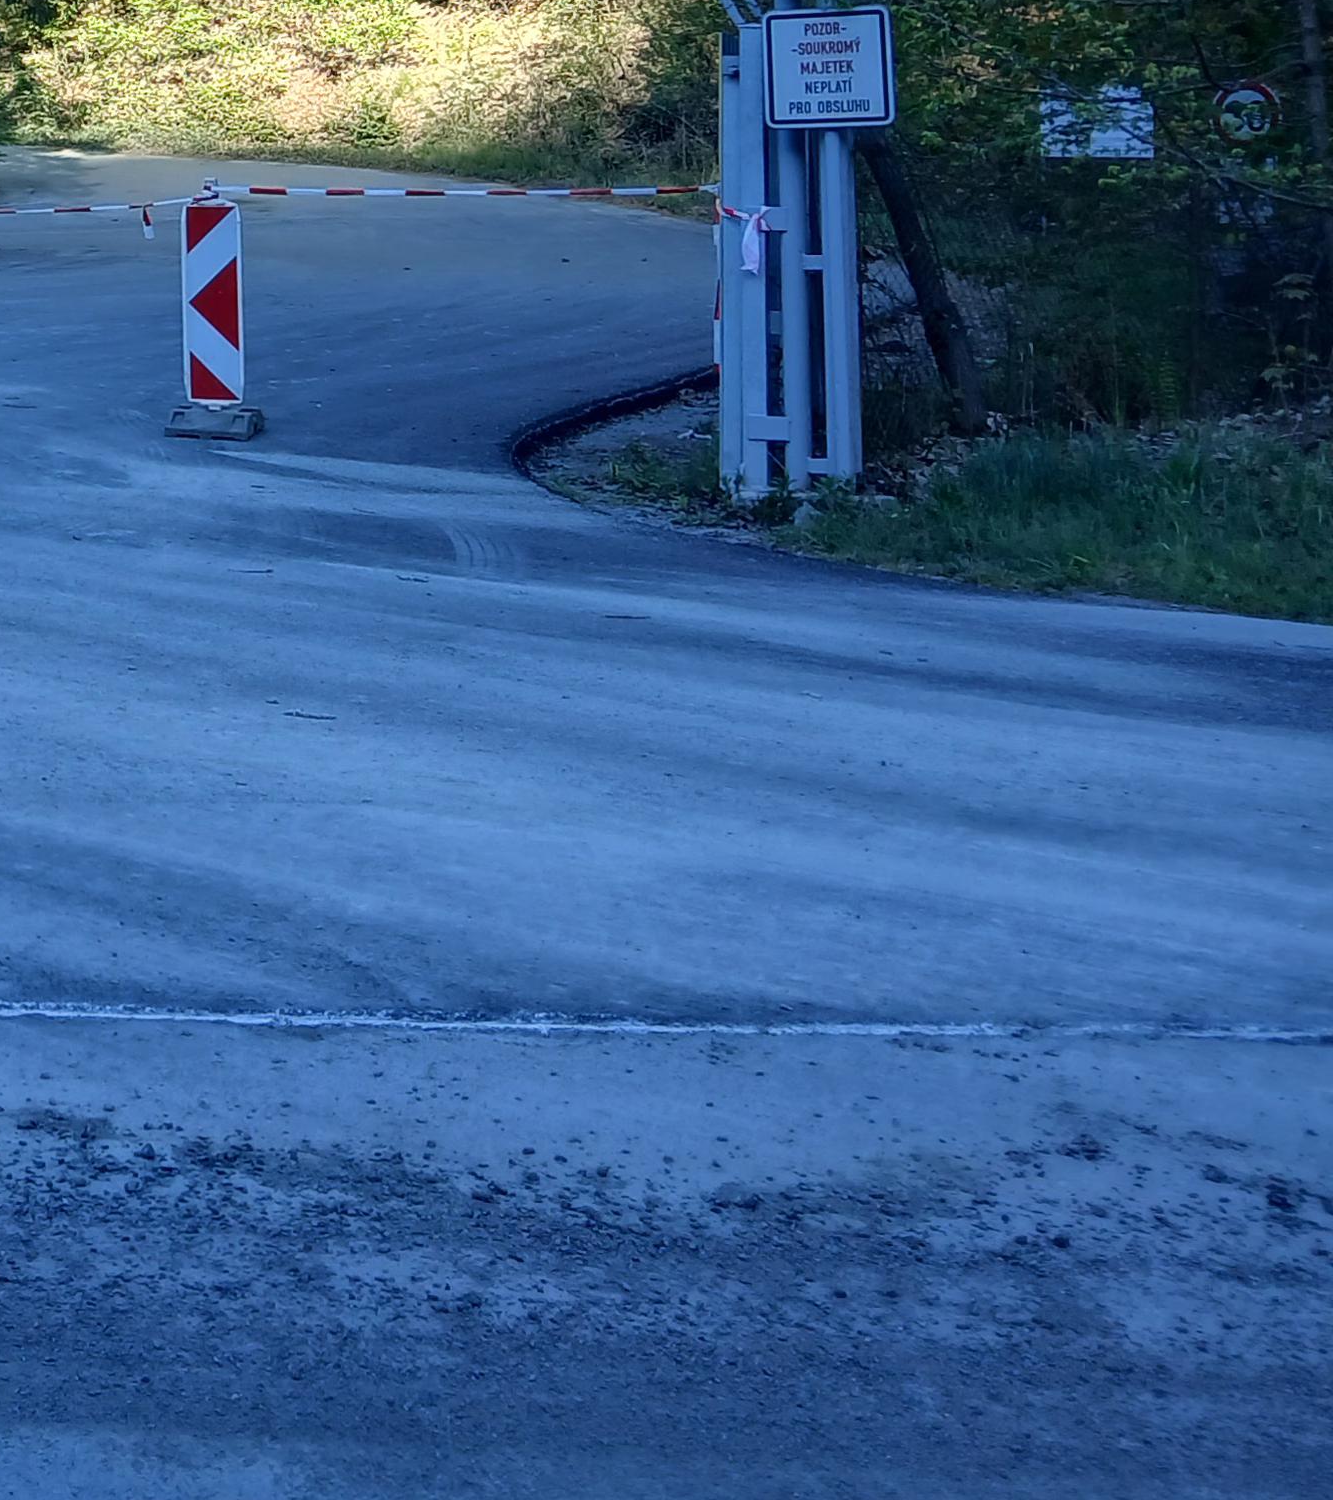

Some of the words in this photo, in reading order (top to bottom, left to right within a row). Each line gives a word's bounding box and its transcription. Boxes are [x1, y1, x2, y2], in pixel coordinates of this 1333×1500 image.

[800, 59, 854, 75] MAJETEK
[805, 77, 852, 94] NEPLATÍ
[789, 101, 812, 115] PRO
[817, 99, 870, 114] OBSLUHU
